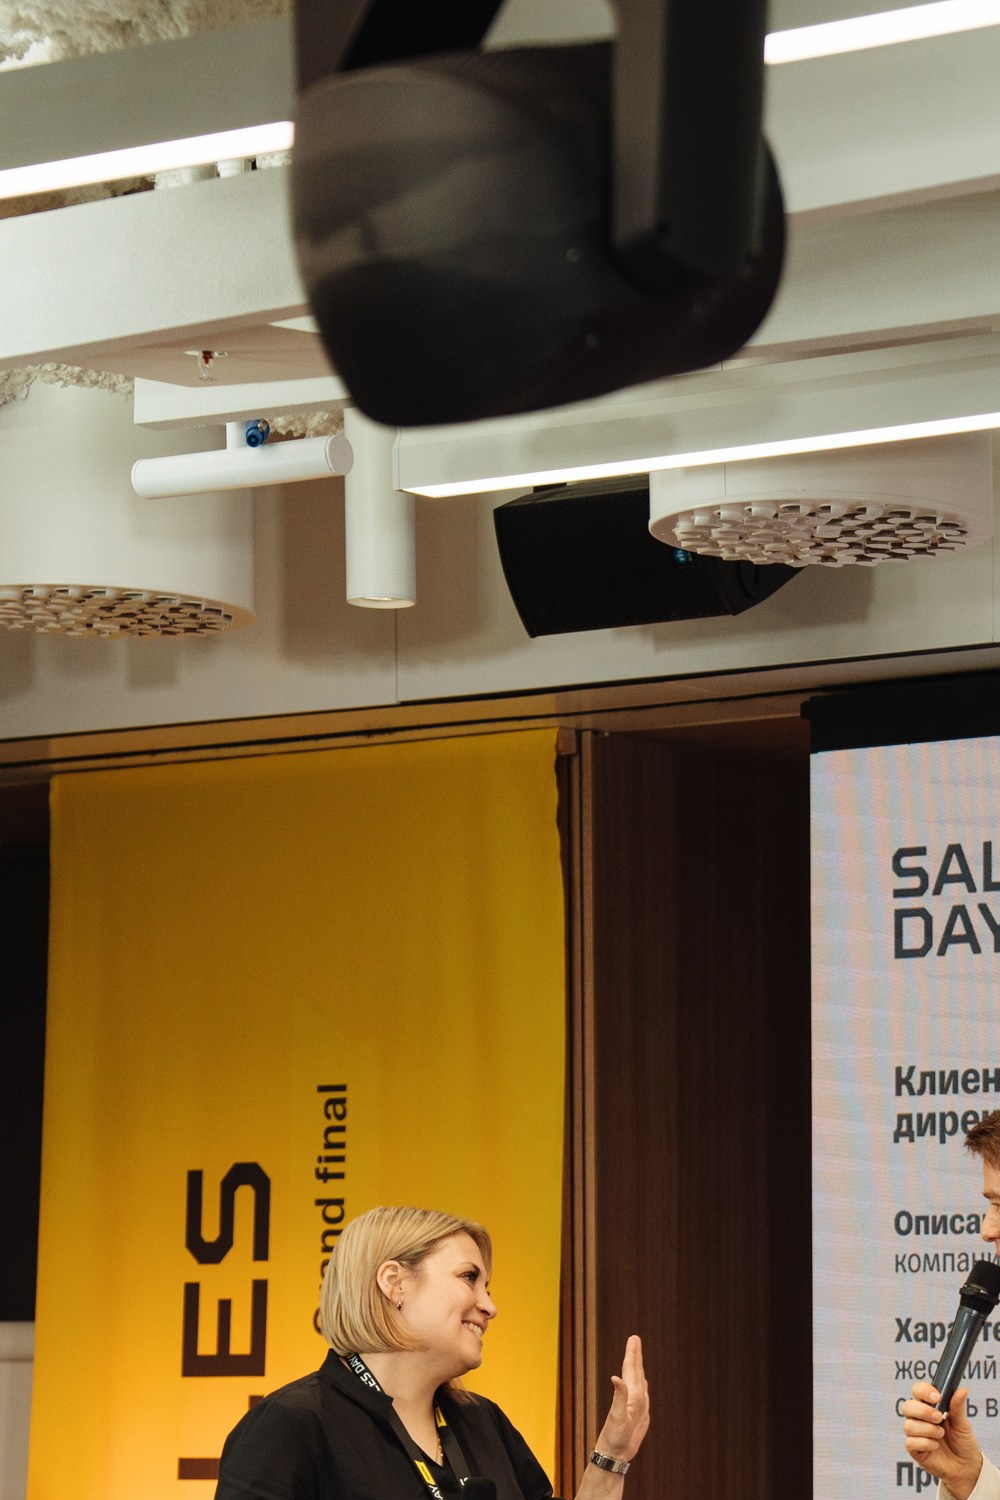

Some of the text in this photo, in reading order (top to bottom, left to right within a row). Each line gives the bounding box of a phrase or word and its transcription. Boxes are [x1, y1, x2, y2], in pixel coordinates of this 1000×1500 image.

[314, 1084, 347, 1183] final
[893, 1107, 999, 1144] дире
[894, 1210, 984, 1236] Описа
